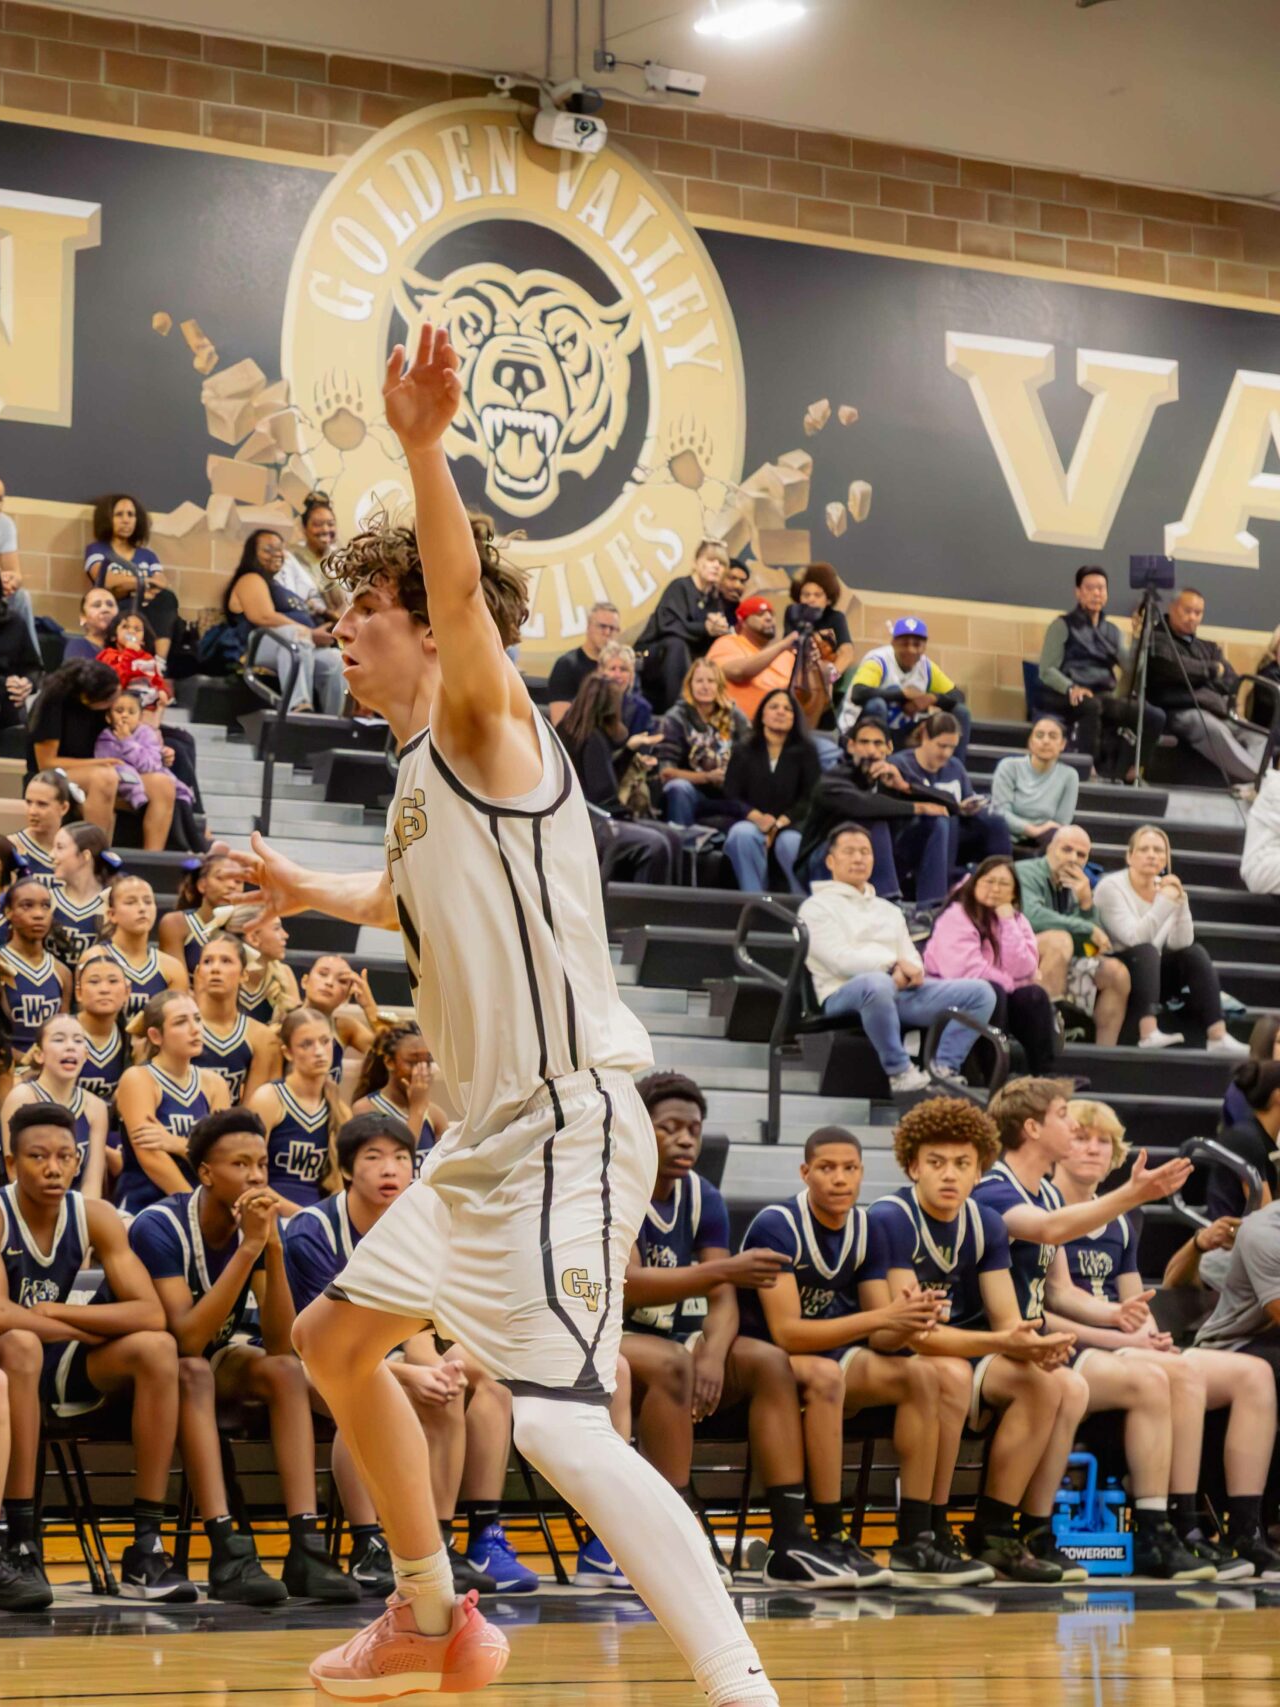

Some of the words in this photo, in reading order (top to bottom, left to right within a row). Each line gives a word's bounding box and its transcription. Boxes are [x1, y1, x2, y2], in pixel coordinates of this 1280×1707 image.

[308, 124, 520, 322] GOLDEN
[554, 148, 724, 375] VALLEY
[561, 1267, 602, 1313] GV
